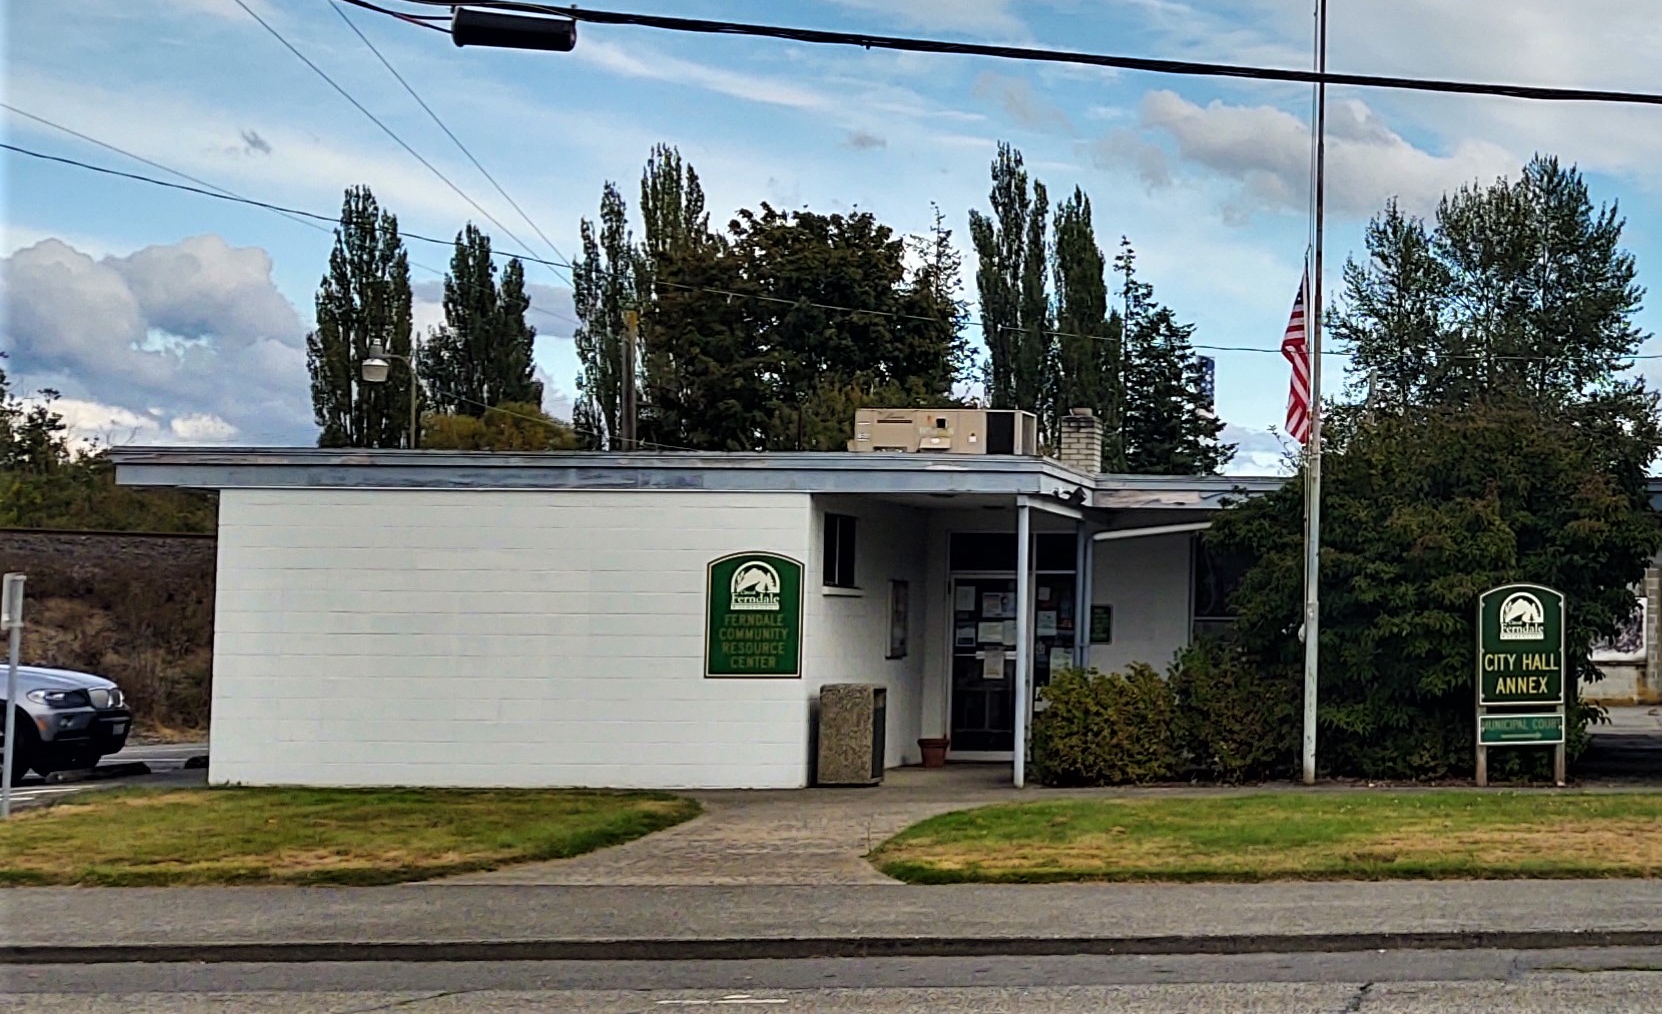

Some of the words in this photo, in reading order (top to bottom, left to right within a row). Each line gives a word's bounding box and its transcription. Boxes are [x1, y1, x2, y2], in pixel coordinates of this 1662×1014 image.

[731, 592, 780, 604] Ferndale
[724, 614, 784, 627] FERNDALE
[719, 628, 789, 640] COMMUNITY
[1500, 622, 1544, 634] Ferndale
[722, 641, 785, 654] RESOURCE
[730, 656, 776, 668] CENTER
[1484, 653, 1517, 671] CITY
[1522, 653, 1559, 671] HALL
[1495, 676, 1549, 694] ANNEX
[1481, 718, 1529, 731] MUNICIPAL
